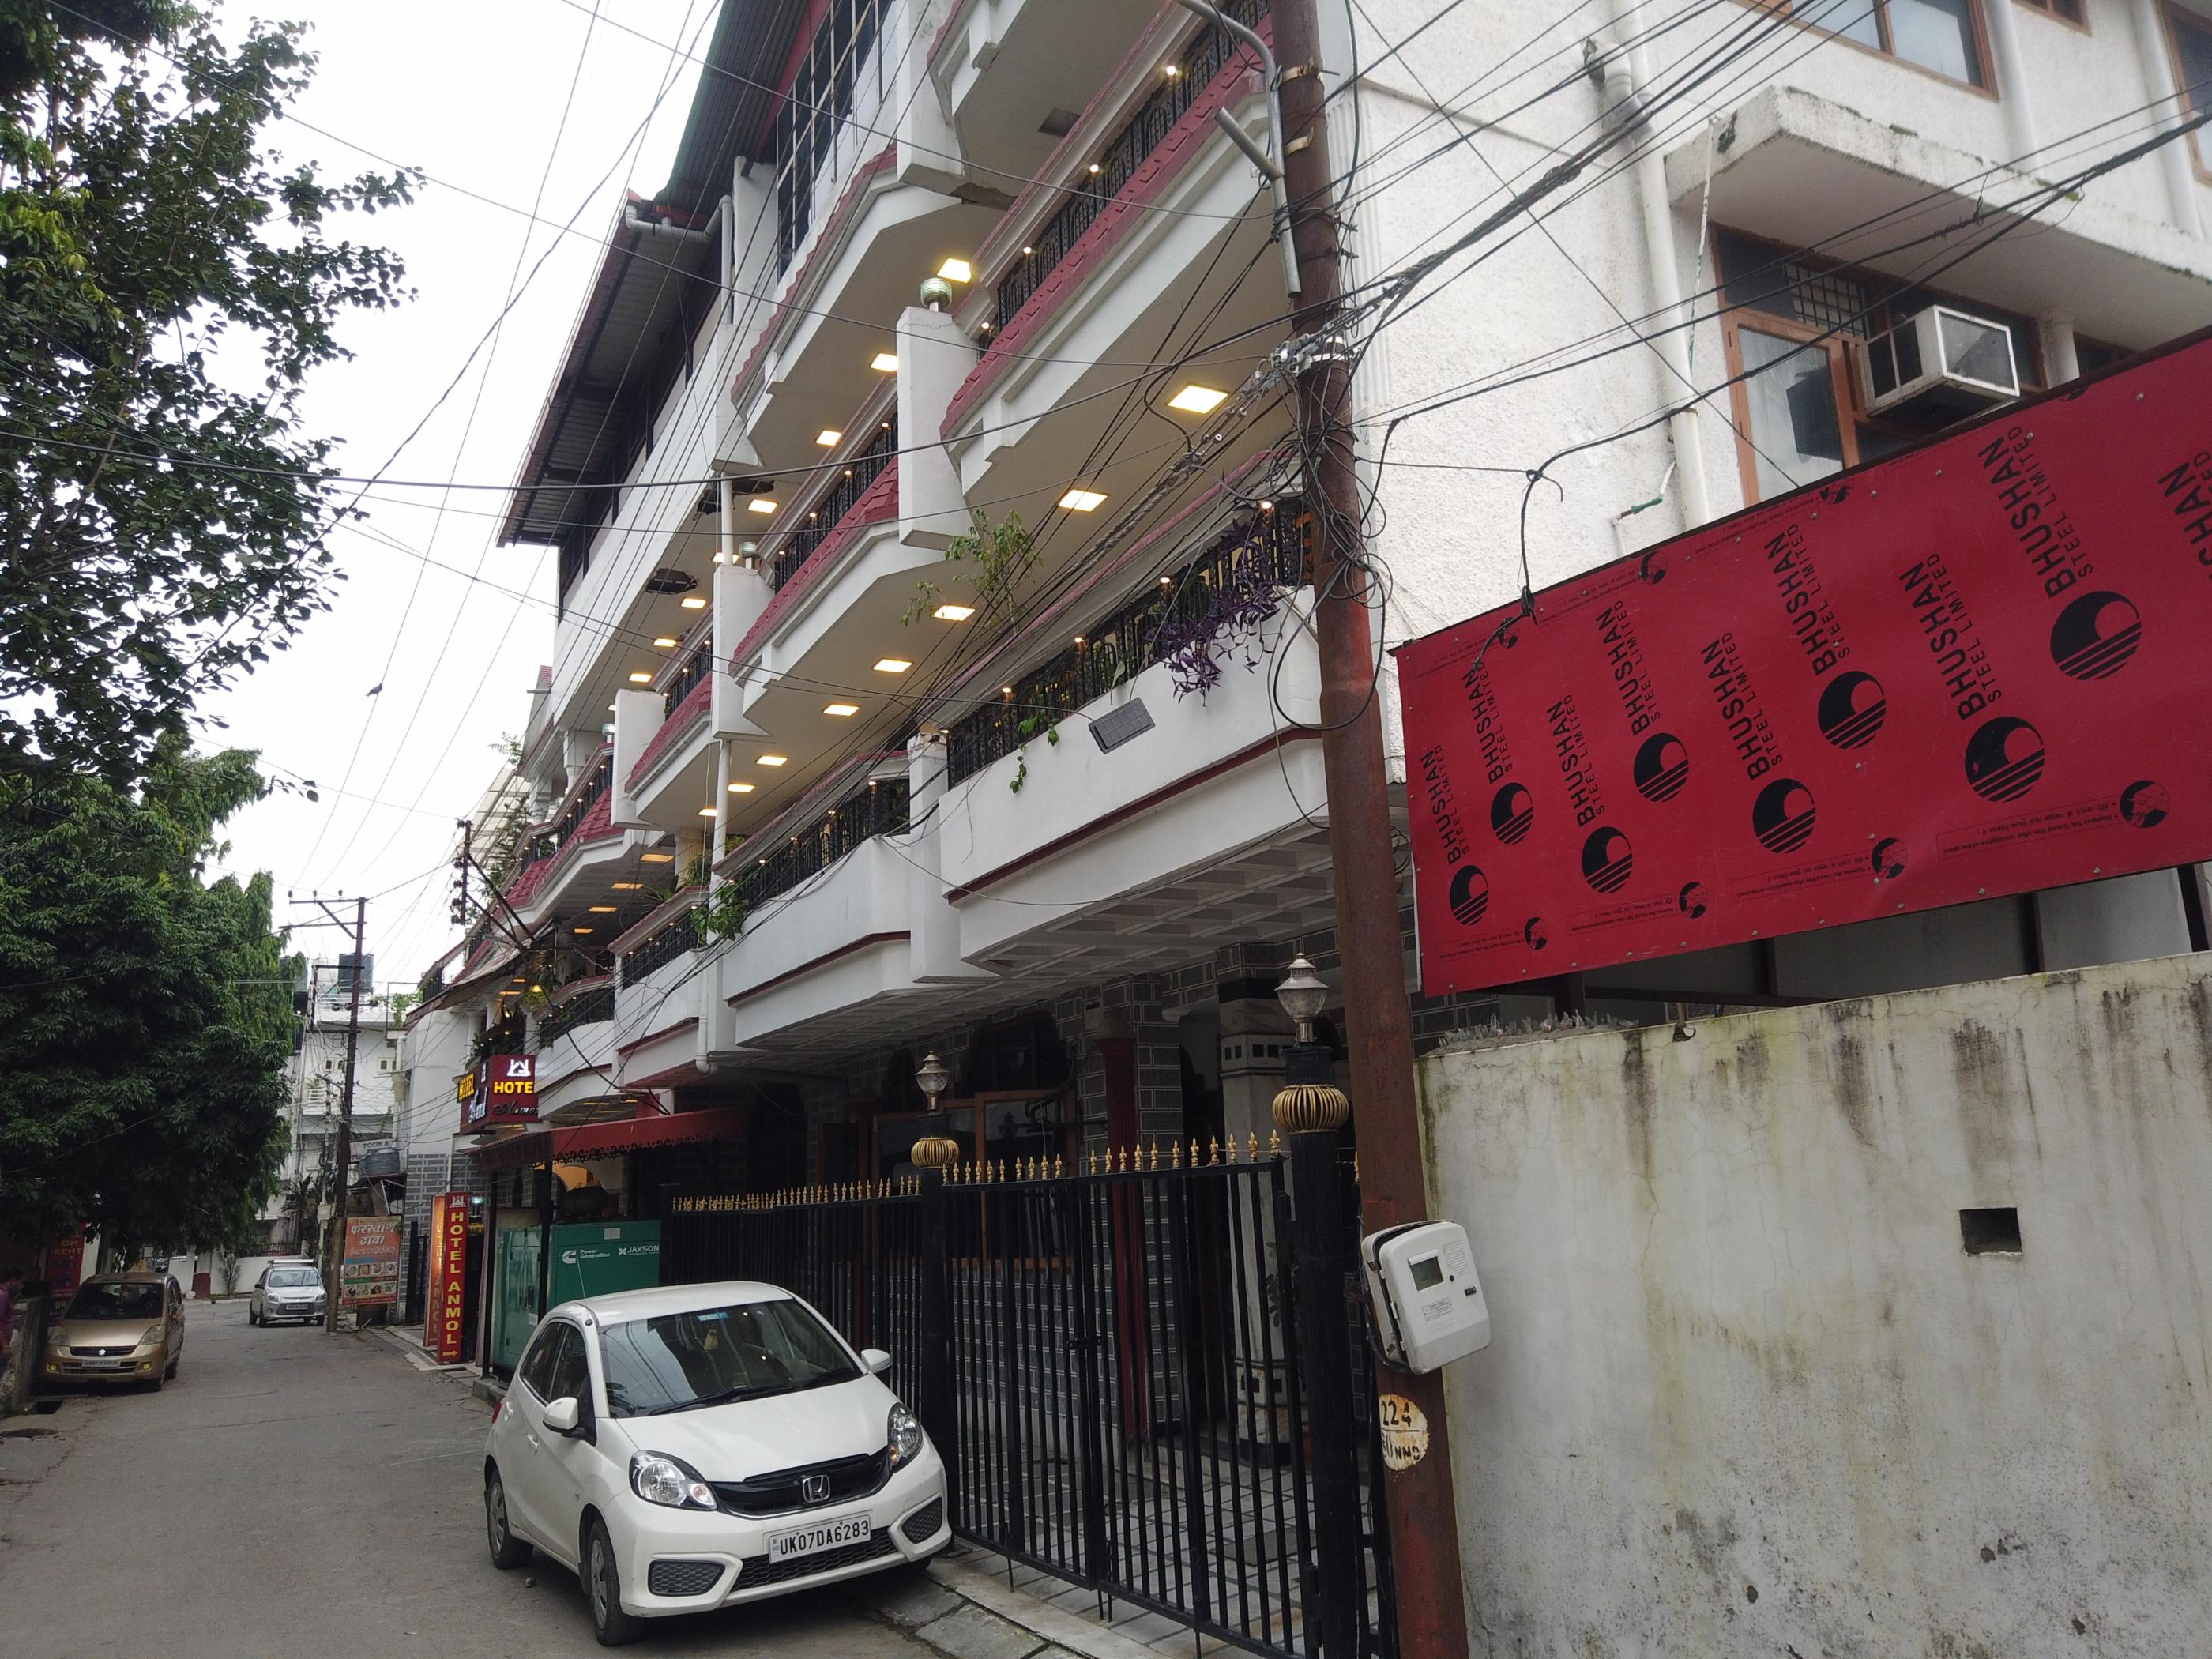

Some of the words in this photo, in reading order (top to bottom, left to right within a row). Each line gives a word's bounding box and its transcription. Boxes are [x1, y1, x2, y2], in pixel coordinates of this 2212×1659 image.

[2007, 426, 2057, 507] LIMITED
[1977, 436, 2077, 599] BHUSHAN
[2053, 513, 2094, 578] STEEL
[1787, 524, 1821, 595] LIMITED
[1764, 532, 1838, 675] BHUSHAN
[1926, 553, 1973, 633] LIMITED
[1613, 600, 1648, 668] LIMITED
[1819, 601, 1850, 659] STEEL
[1898, 562, 1987, 721] BHUSHAN
[1476, 663, 1501, 718] LIMITED
[1596, 608, 1650, 736] BHUSHAN
[1639, 670, 1661, 722] STEEL
[1721, 632, 1756, 703] LIMITED
[1968, 638, 2002, 702] STEEL
[1463, 669, 1505, 784] BHUSHAN
[1562, 694, 1589, 760] LIMITED
[1701, 639, 1770, 781] BHUSHAN
[1752, 708, 1783, 766] STEEL
[1435, 744, 1452, 803] LIMITED
[1495, 722, 1514, 773] STEEL
[1547, 701, 1596, 828] BHUSHAN
[1420, 750, 1462, 866] BHUSHAN
[1582, 762, 1605, 814] STEEL
[1450, 808, 1470, 855] STEEL
[494, 1082, 533, 1094] HOTE
[450, 1212, 465, 1274] HOTEL
[445, 1281, 461, 1345] ANMOL
[780, 1521, 869, 1555] UK07DA6283
